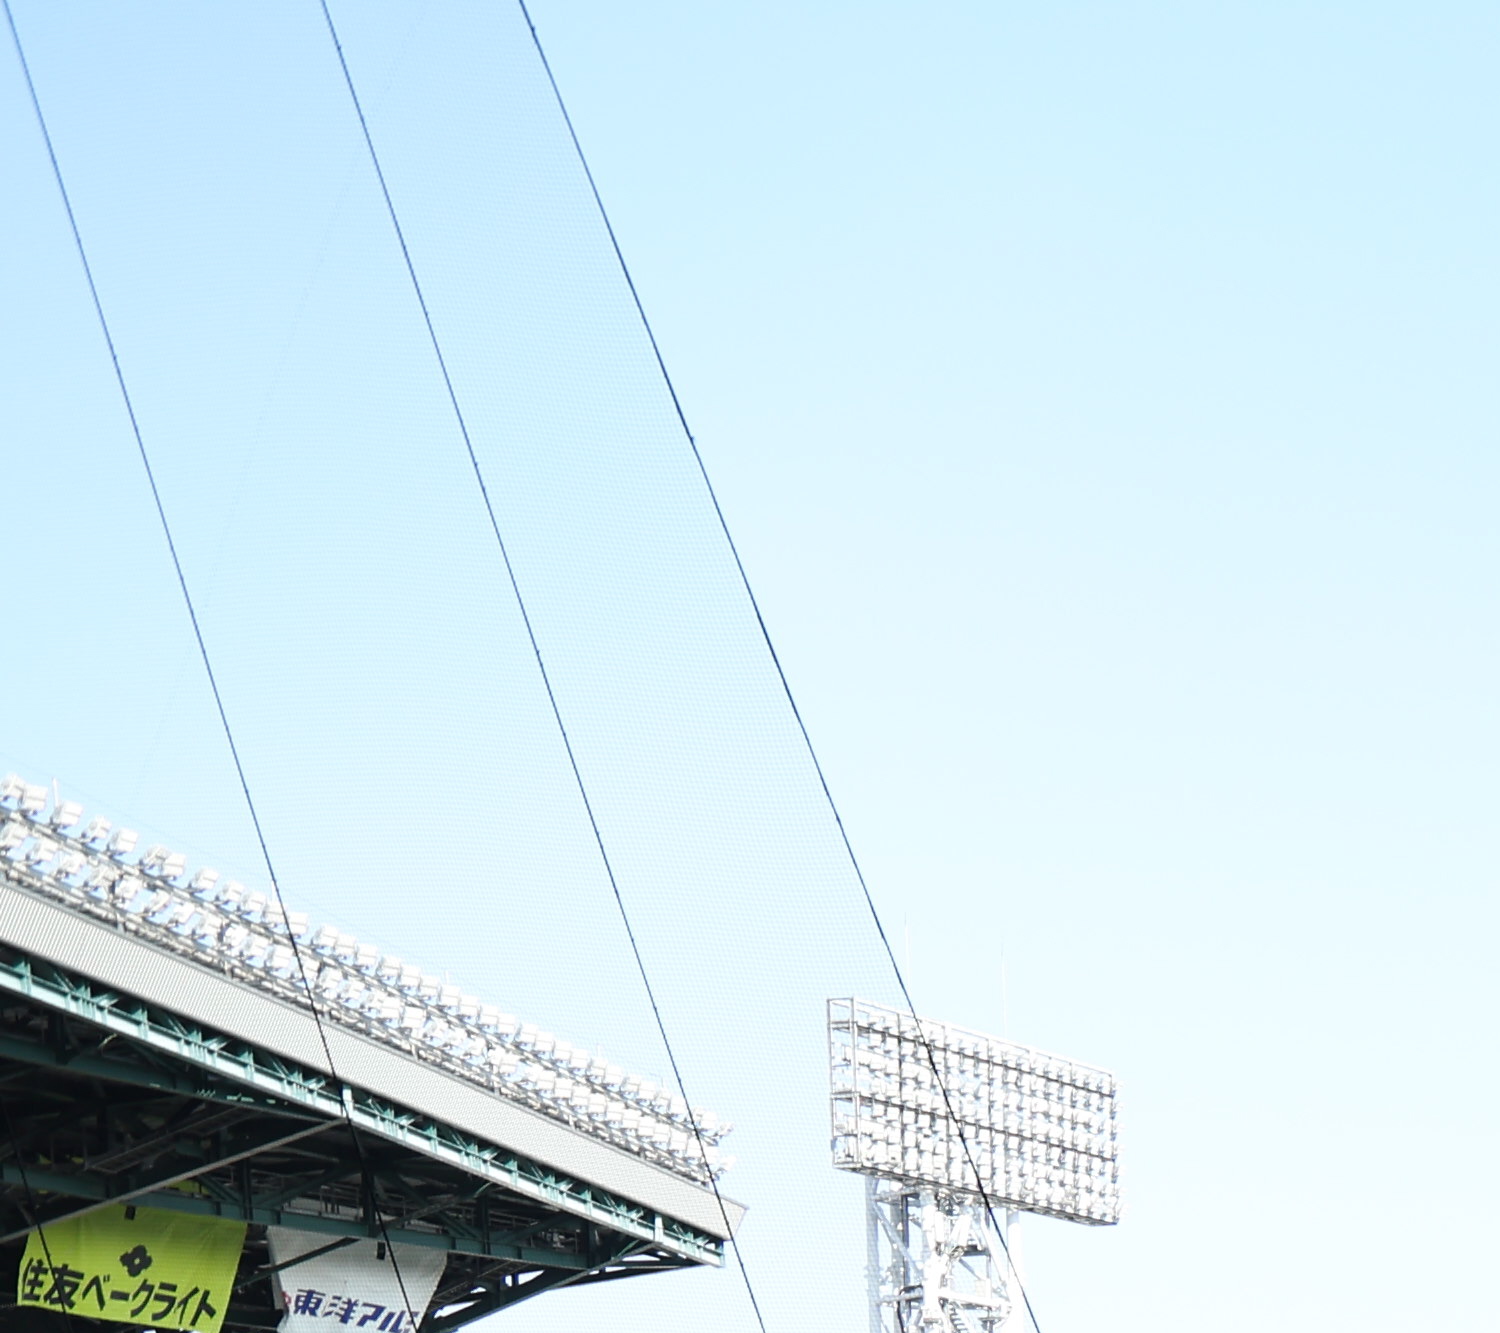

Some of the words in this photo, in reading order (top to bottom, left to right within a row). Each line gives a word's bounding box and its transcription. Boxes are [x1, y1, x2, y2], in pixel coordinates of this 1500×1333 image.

[21, 1257, 217, 1329] 住友ベークライト
